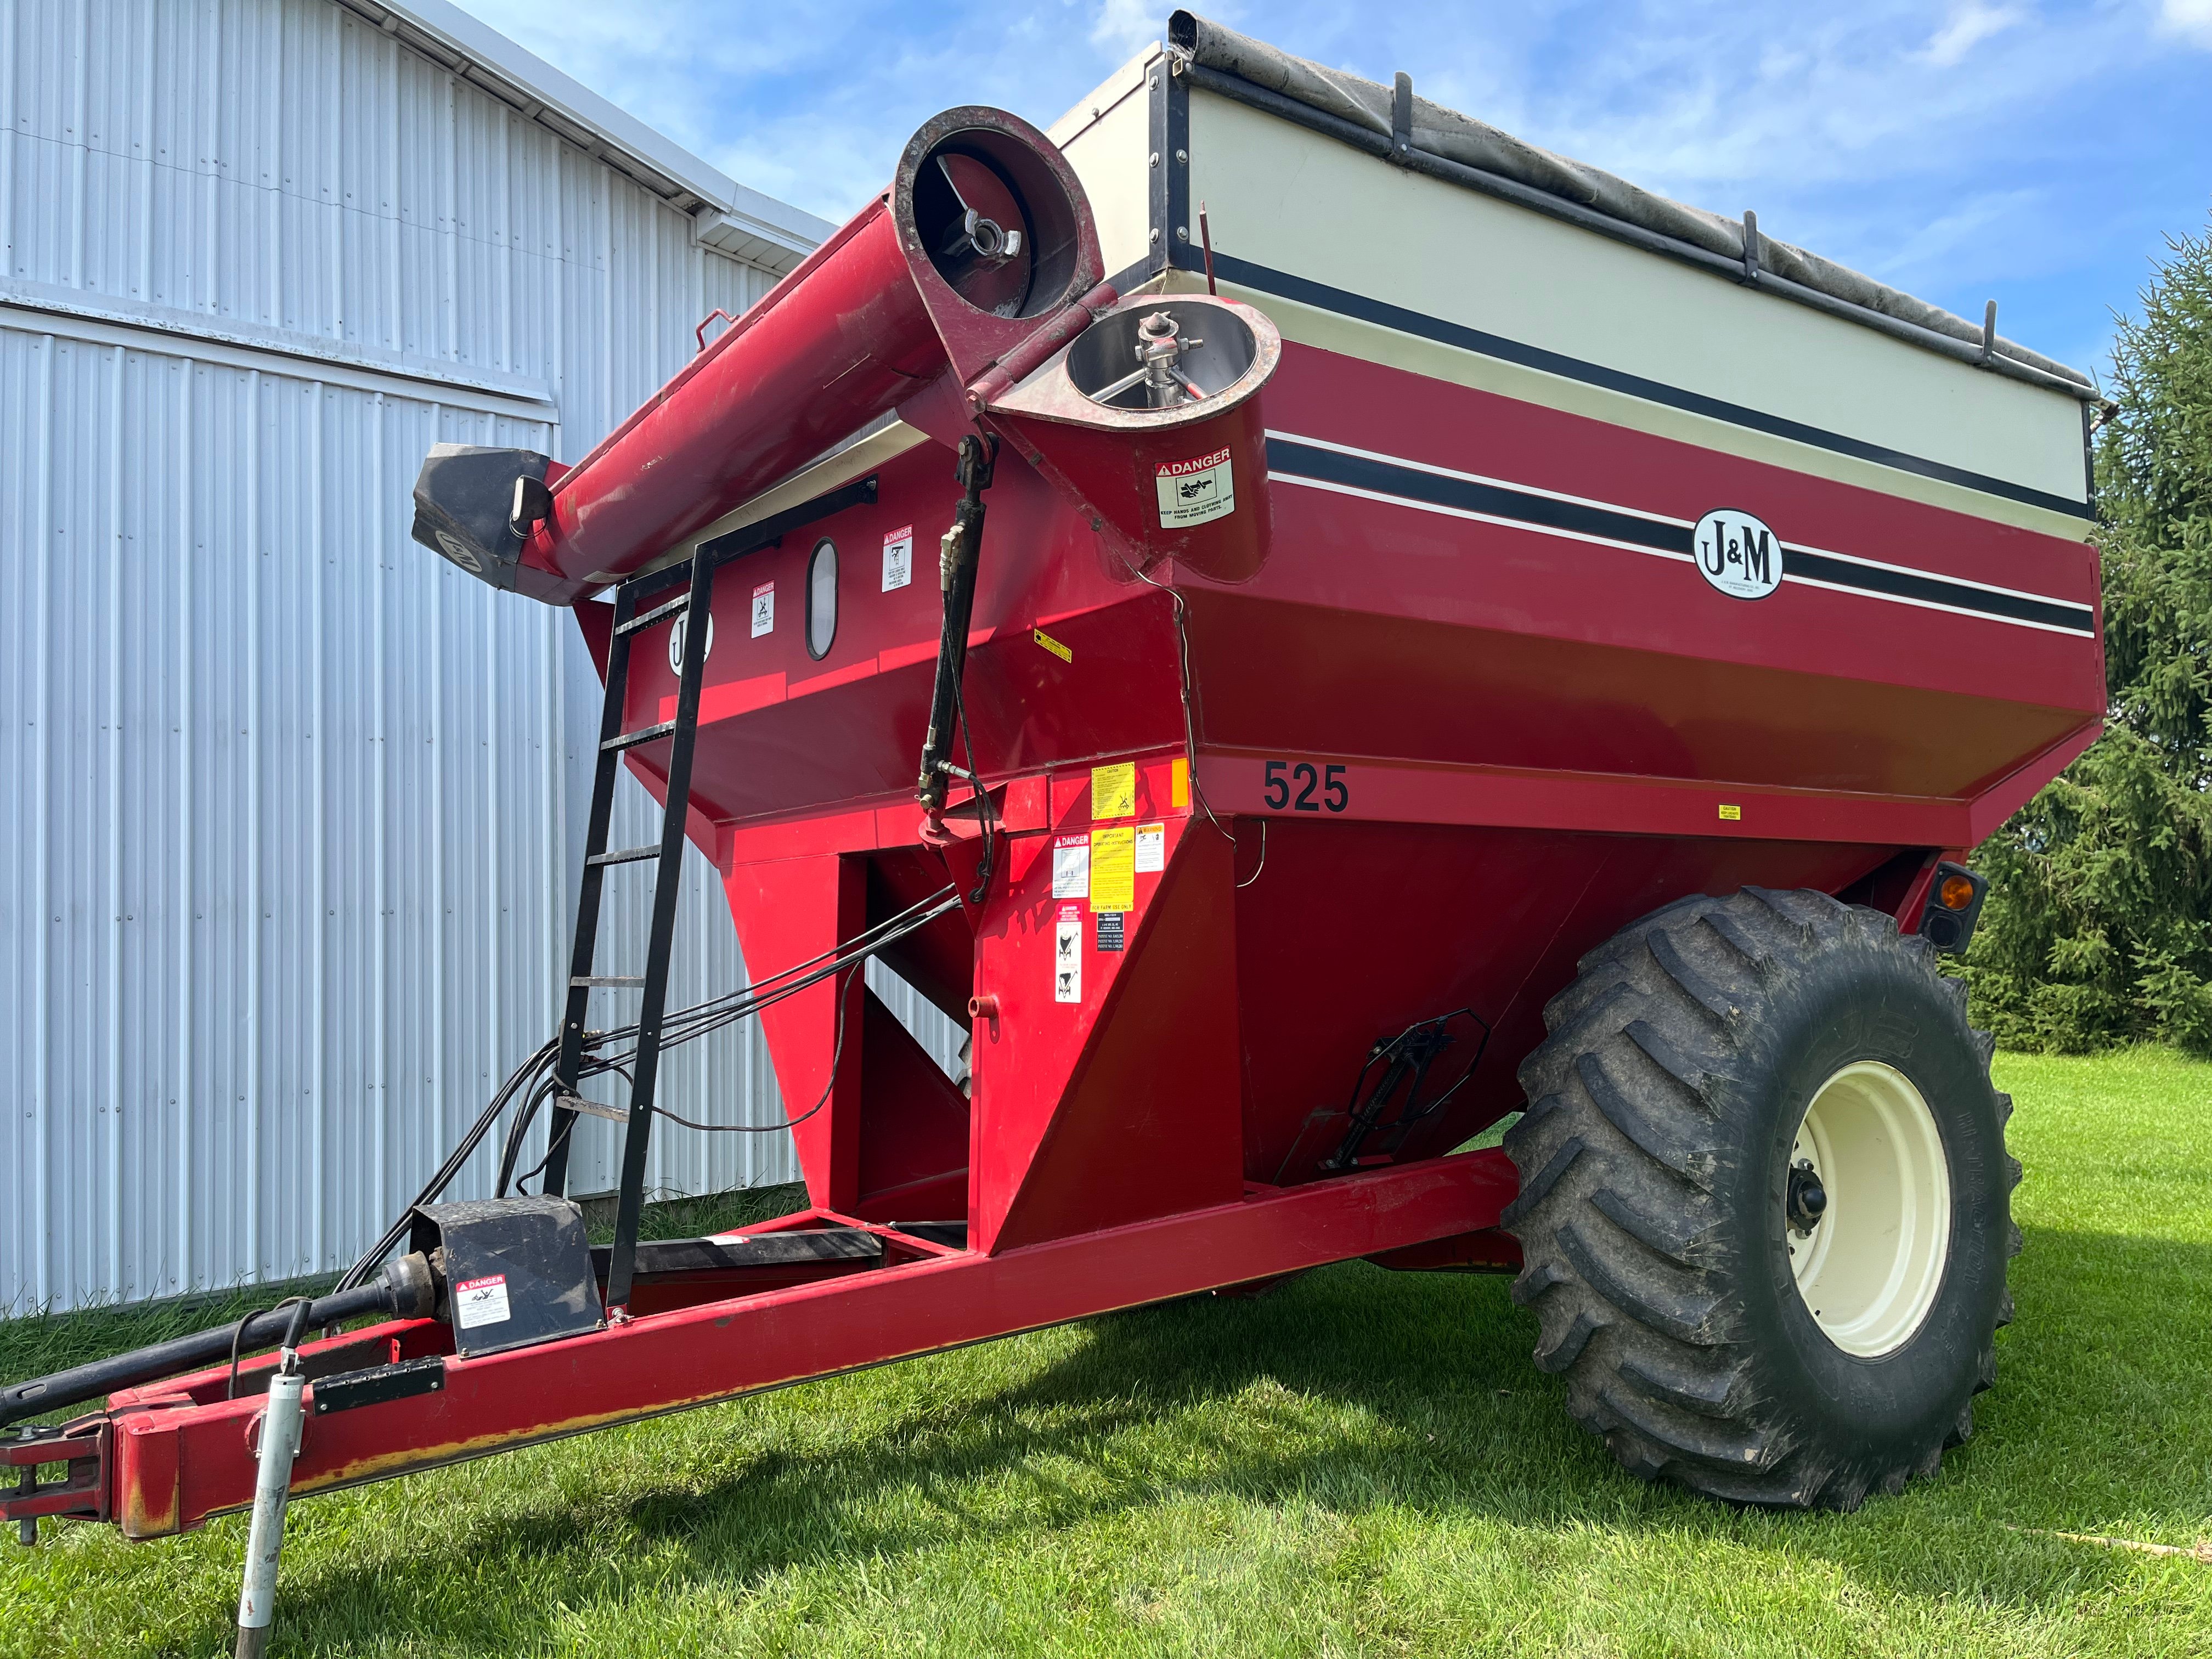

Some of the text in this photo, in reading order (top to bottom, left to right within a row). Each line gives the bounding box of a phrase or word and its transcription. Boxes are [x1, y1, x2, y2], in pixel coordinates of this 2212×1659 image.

[1172, 448, 1229, 475] DANGER
[1201, 499, 1222, 509] CLOTHING
[1223, 494, 1233, 503] AWAY
[889, 526, 912, 543] DANGER
[440, 533, 482, 569] J&M
[1702, 520, 1773, 585] J&M
[757, 582, 774, 595] DANGER
[1264, 761, 1348, 812] 525
[1062, 835, 1088, 847] DANGER
[469, 1276, 503, 1289] DANGER
